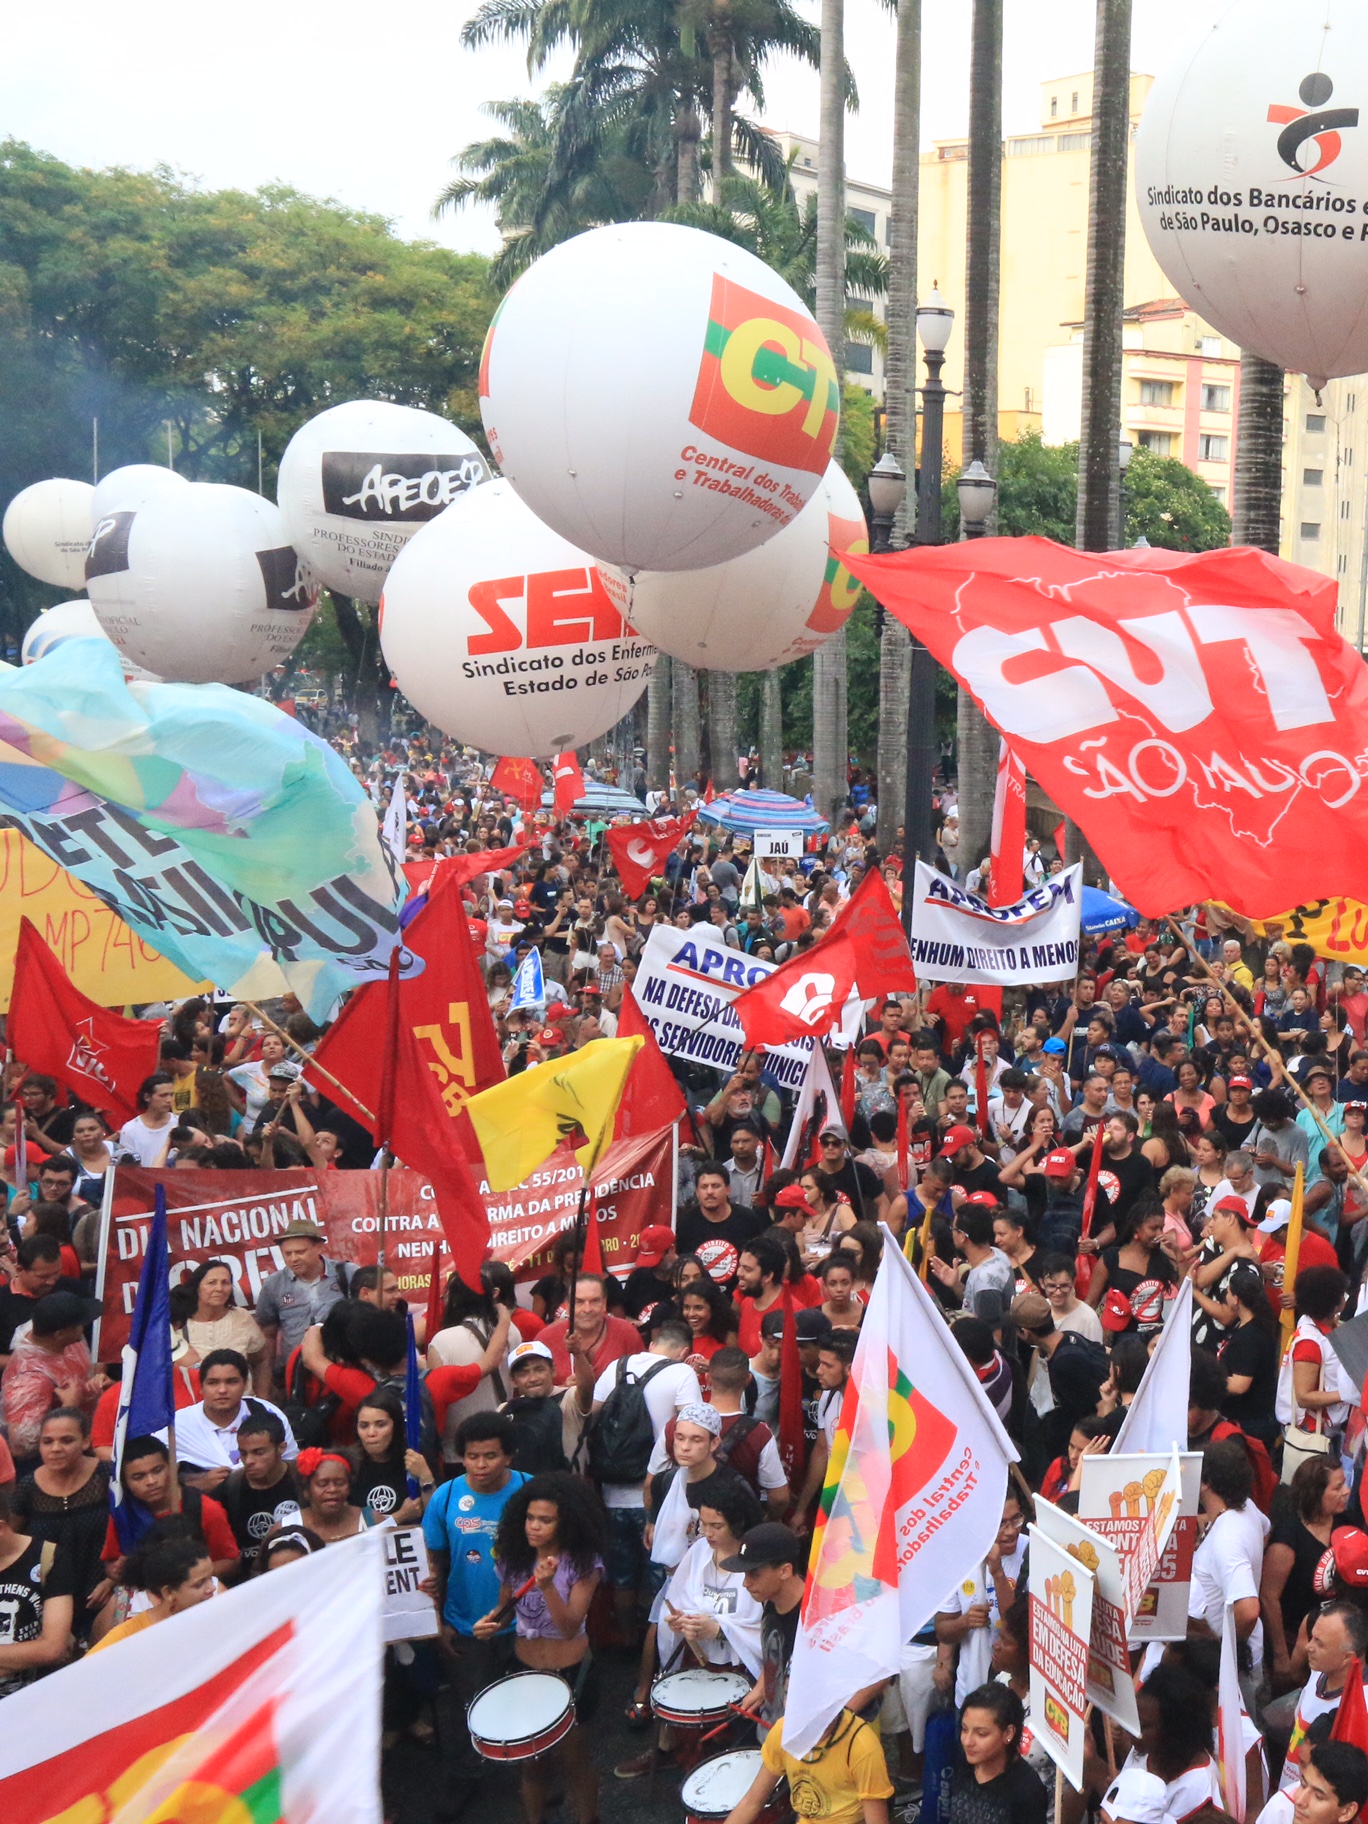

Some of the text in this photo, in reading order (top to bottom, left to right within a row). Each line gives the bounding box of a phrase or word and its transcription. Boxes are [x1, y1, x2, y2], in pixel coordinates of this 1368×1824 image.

[1148, 185, 1203, 206] Sindicato
[1207, 186, 1243, 207] dos
[1249, 188, 1356, 214] Bancários
[1160, 212, 1174, 231] de
[1177, 212, 1198, 231] São
[1201, 212, 1259, 236] Paulo,
[1263, 216, 1336, 239] Osasco
[1342, 225, 1354, 241] e
[720, 317, 841, 457] CT
[680, 444, 778, 493] Central dos
[674, 468, 783, 526] e Trabalhadoras
[313, 528, 399, 553] PROFESSORES
[337, 543, 396, 562] DO ESTAD
[372, 530, 411, 546] SINDI
[349, 557, 383, 574] Filiado
[250, 623, 300, 635] PROFESSO
[461, 655, 564, 679] Sindicato
[571, 649, 606, 667] dos
[952, 605, 1335, 744] CUT
[503, 675, 577, 696] Estado
[585, 669, 608, 686] de
[614, 666, 639, 682] São
[1062, 736, 1188, 804] SÃO
[769, 839, 789, 855] JAÚ
[928, 873, 1076, 921] APROFEM
[966, 945, 1017, 971] DIREITO
[1020, 947, 1031, 969] A
[1033, 938, 1080, 969] MENOS
[642, 975, 666, 1006] NA
[665, 983, 721, 1024] DEFESA
[532, 1165, 585, 1188] 55/201
[528, 1199, 550, 1216] DA
[181, 1197, 326, 1251] NACIONAL
[546, 1221, 557, 1235] A
[1086, 1520, 1139, 1533] ESTAMOS
[0, 1583, 31, 1598] THENS
[1032, 1600, 1060, 1635] ESTAMOS
[1069, 1635, 1087, 1664] LUTA
[1033, 1617, 1085, 1690] EM DEFESA
[1032, 1643, 1085, 1713] DA EDUCAÇÃO
[1046, 1697, 1068, 1736] CTB
